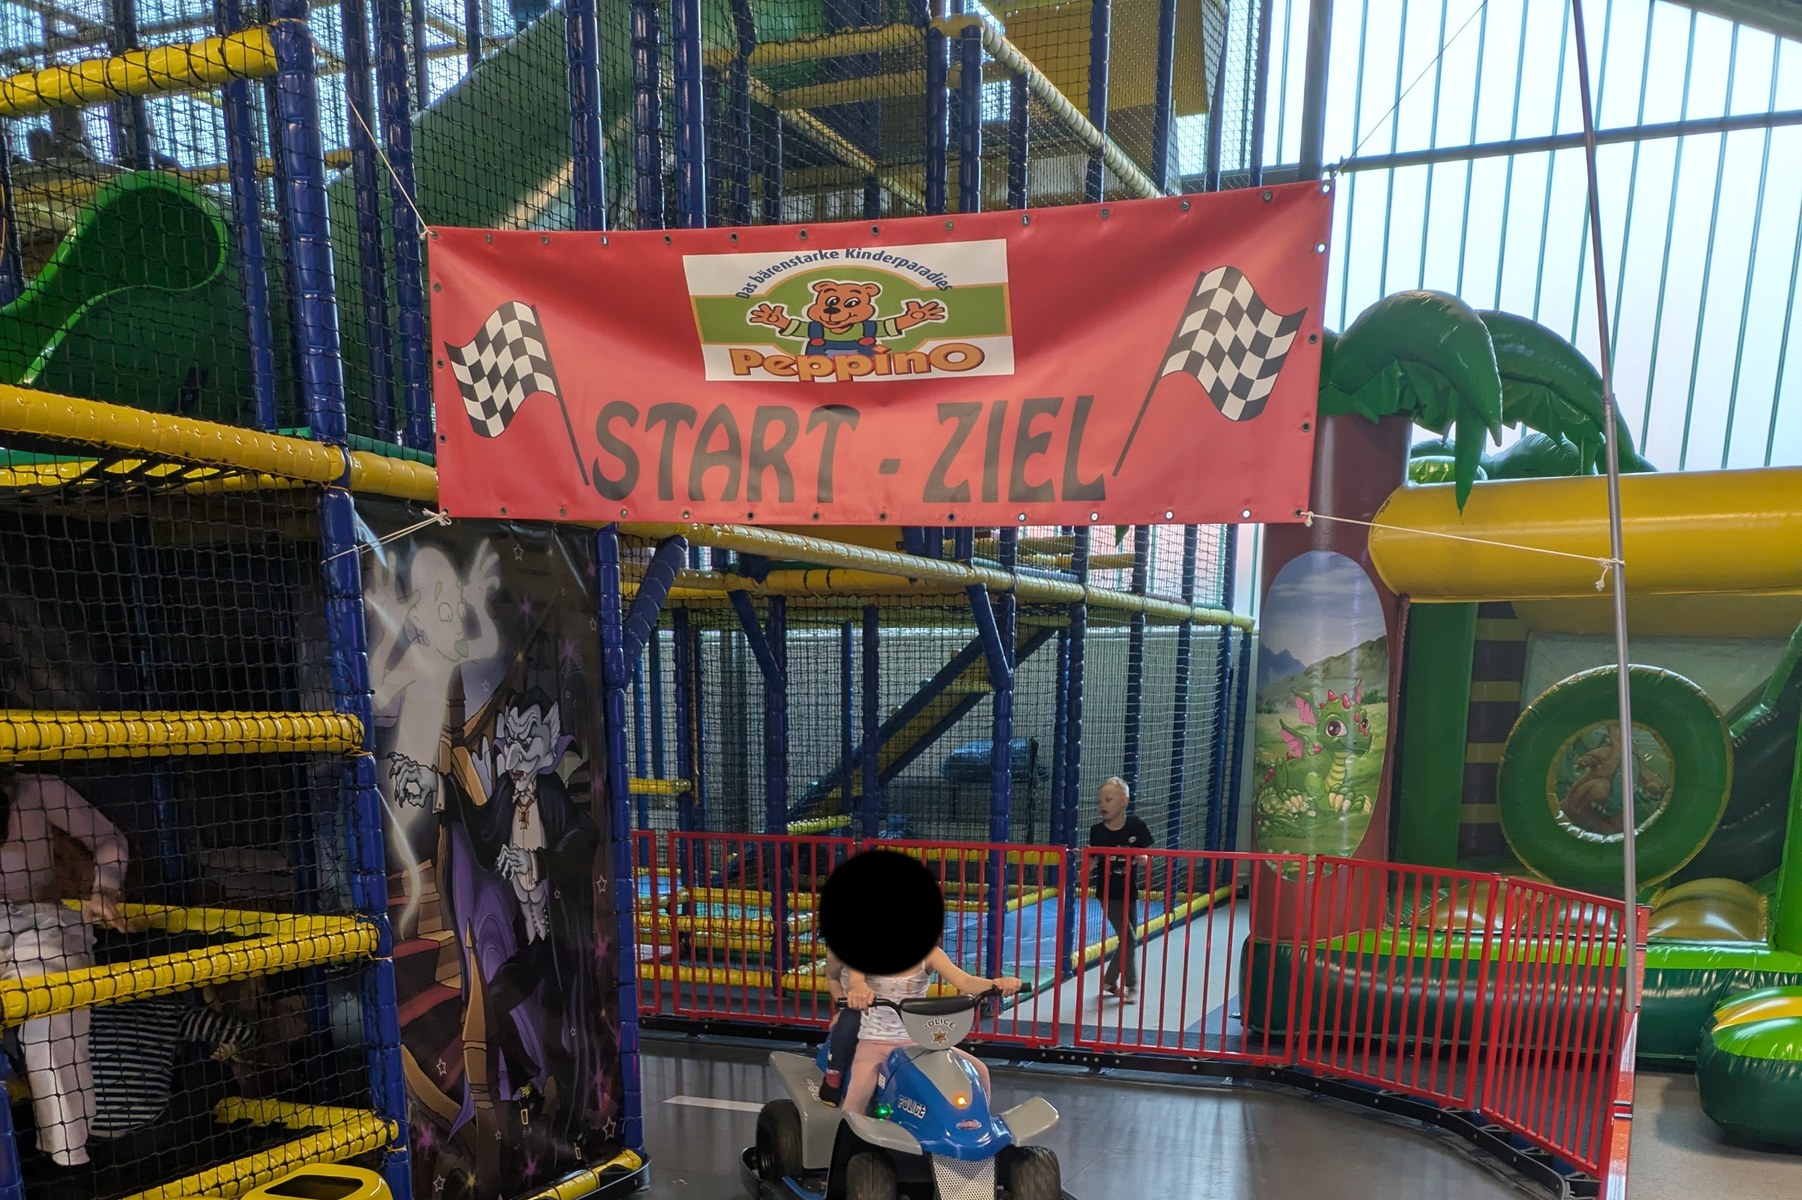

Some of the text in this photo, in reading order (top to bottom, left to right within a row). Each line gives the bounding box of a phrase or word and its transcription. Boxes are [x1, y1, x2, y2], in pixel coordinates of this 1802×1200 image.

[735, 247, 953, 300] Das bärenstarke Kinderparadies
[593, 400, 861, 503] START
[922, 395, 1107, 503] ZIEL
